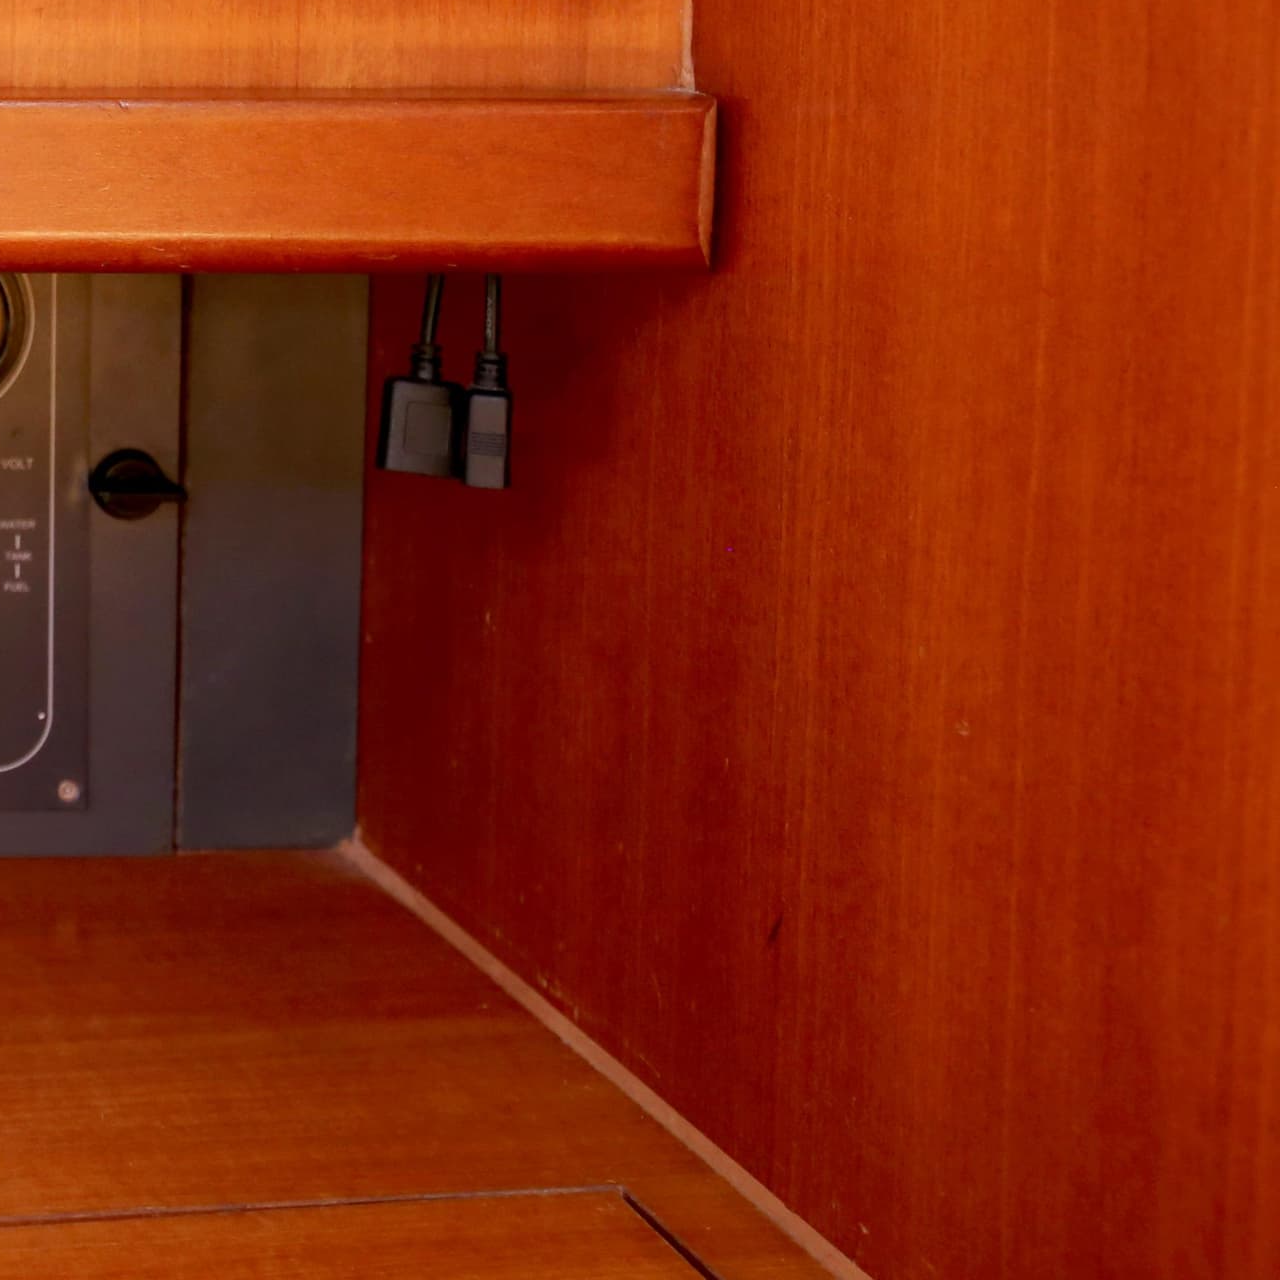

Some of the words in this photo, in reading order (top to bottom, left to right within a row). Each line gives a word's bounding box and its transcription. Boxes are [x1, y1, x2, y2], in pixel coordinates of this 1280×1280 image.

[1, 458, 34, 470] VOLT
[0, 520, 36, 530] WATER
[4, 583, 30, 593] FUEL
